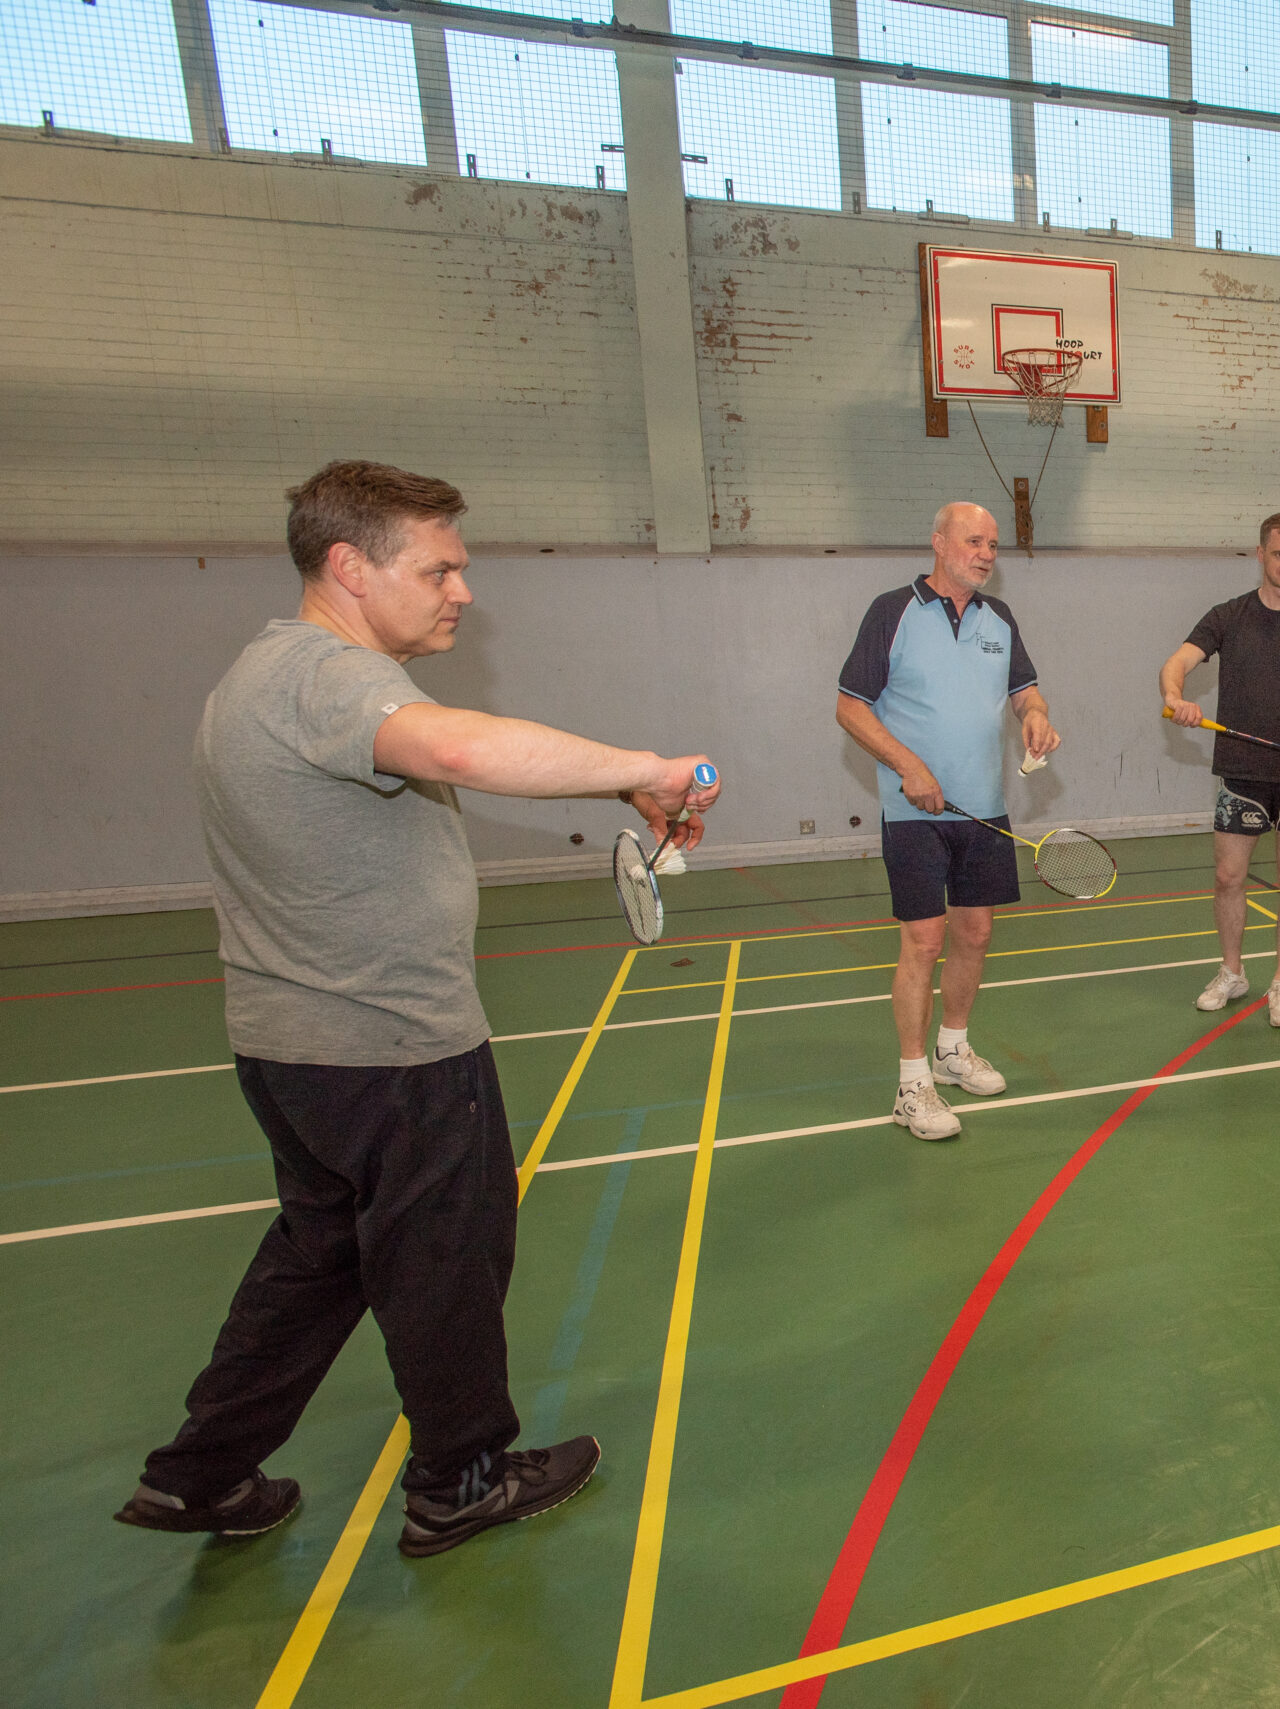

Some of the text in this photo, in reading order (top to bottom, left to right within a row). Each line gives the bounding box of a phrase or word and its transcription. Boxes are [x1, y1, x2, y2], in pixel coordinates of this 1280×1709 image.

[953, 344, 975, 354] SURE
[1056, 339, 1084, 349] HOOP
[953, 359, 975, 370] SHOT
